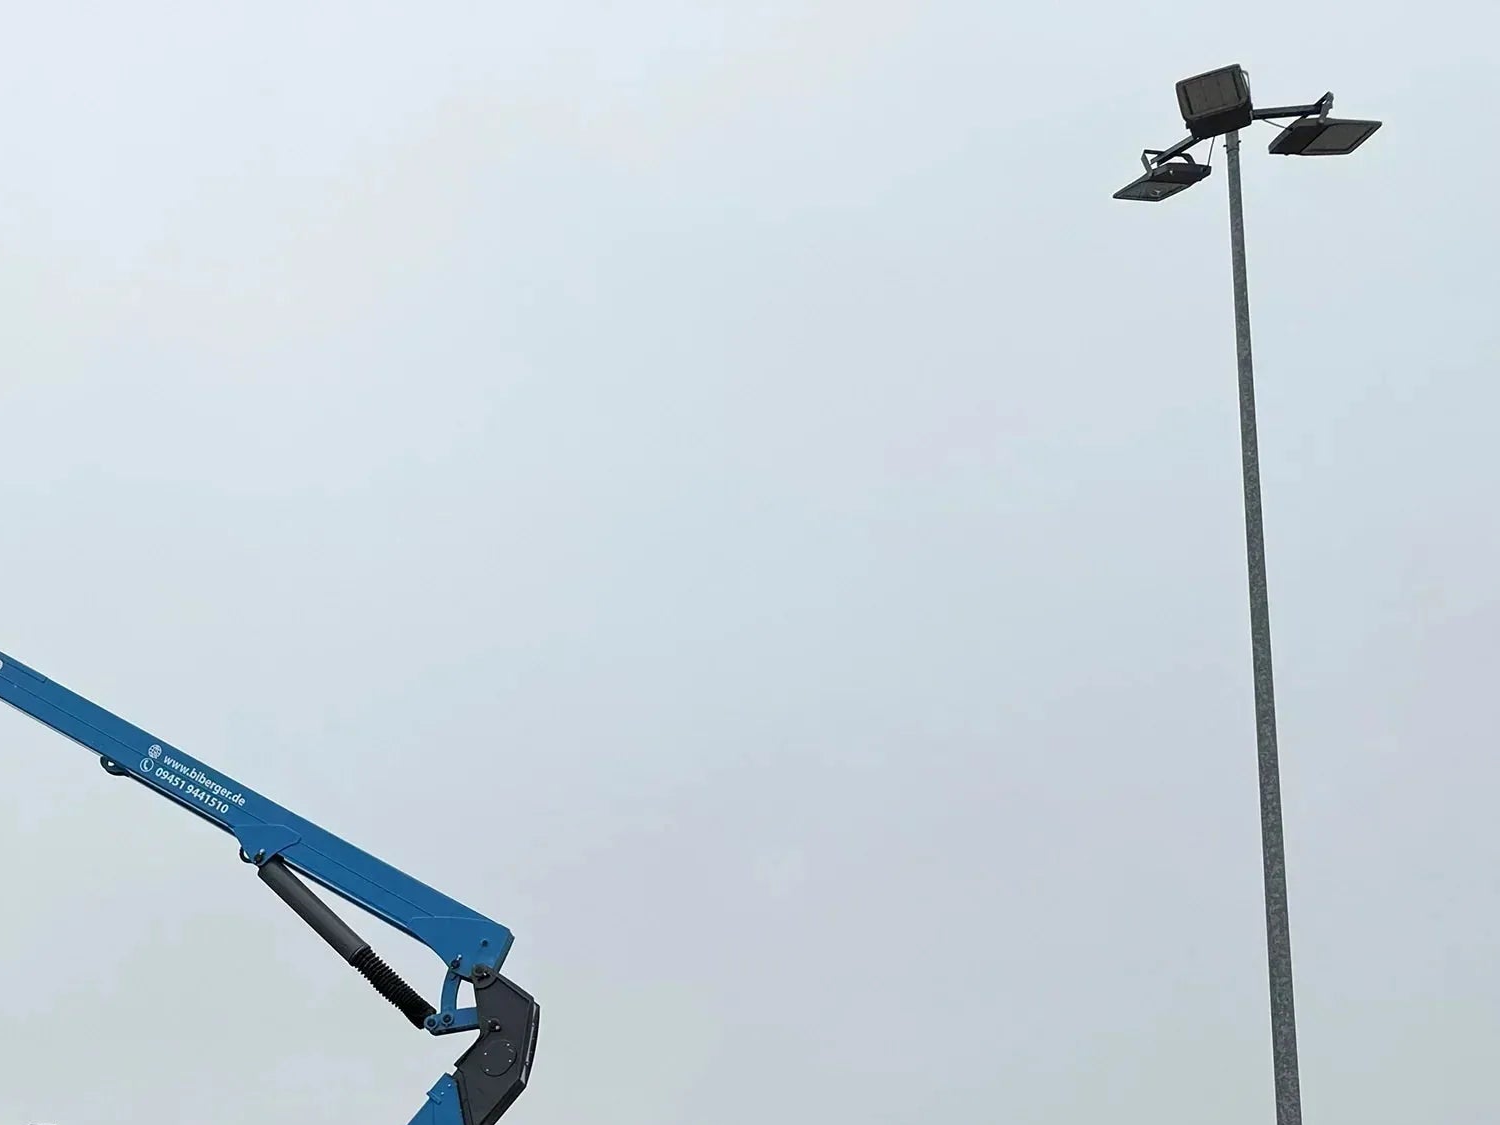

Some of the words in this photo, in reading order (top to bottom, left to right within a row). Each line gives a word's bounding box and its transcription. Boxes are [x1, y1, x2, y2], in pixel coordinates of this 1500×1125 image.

[155, 767, 186, 790] 09451
[185, 784, 229, 814] 9441510
[163, 755, 246, 806] www.biberger.de
